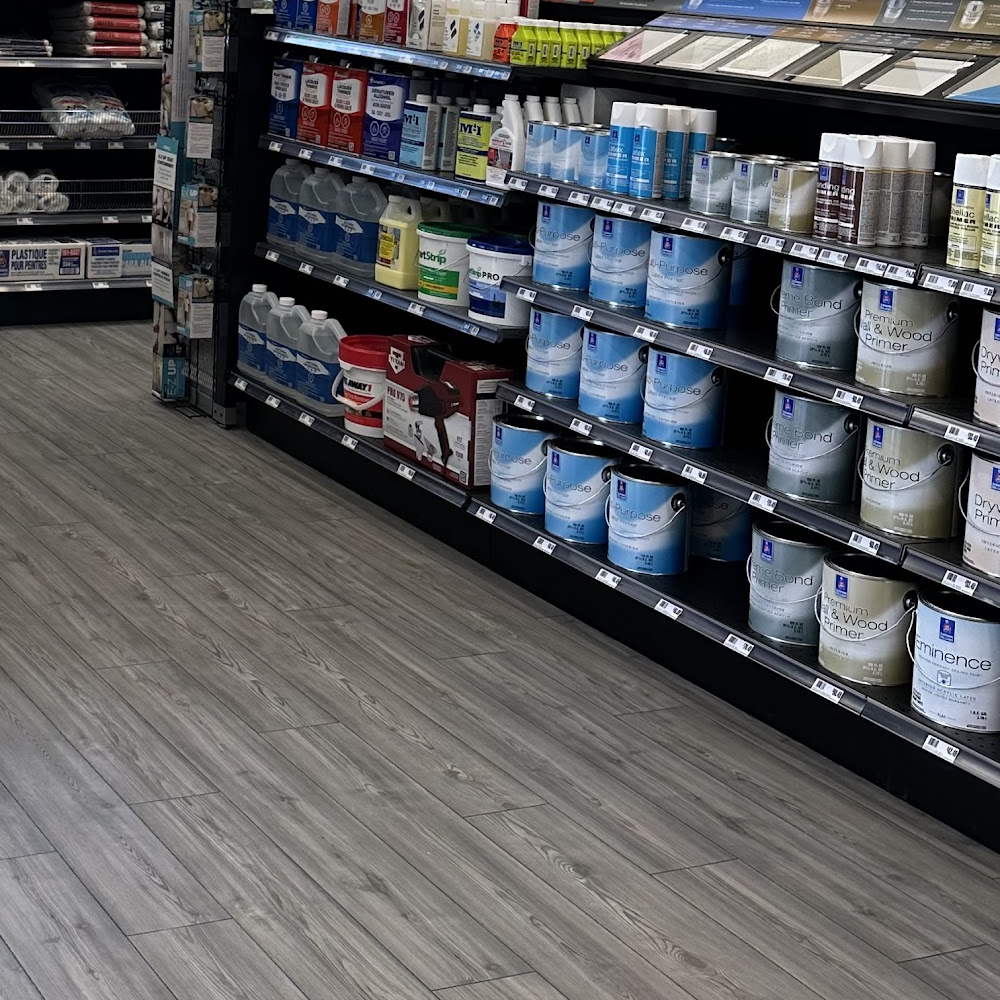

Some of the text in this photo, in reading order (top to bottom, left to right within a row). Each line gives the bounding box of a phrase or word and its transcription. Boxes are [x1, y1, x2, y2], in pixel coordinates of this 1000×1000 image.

[11, 248, 48, 260] PLASTIQUE
[11, 260, 48, 270] POUR PEINTRES
[804, 295, 842, 310] Bond
[865, 309, 914, 328] Premium
[874, 323, 883, 334] &
[886, 325, 932, 343] Wood
[864, 334, 908, 352] Primer
[168, 359, 176, 376] UP
[794, 428, 833, 444] Bond
[868, 461, 920, 483] & Wood
[774, 570, 814, 587] Bond
[824, 591, 869, 618] Premium
[824, 617, 864, 640] Primer
[831, 609, 888, 632] & Wood
